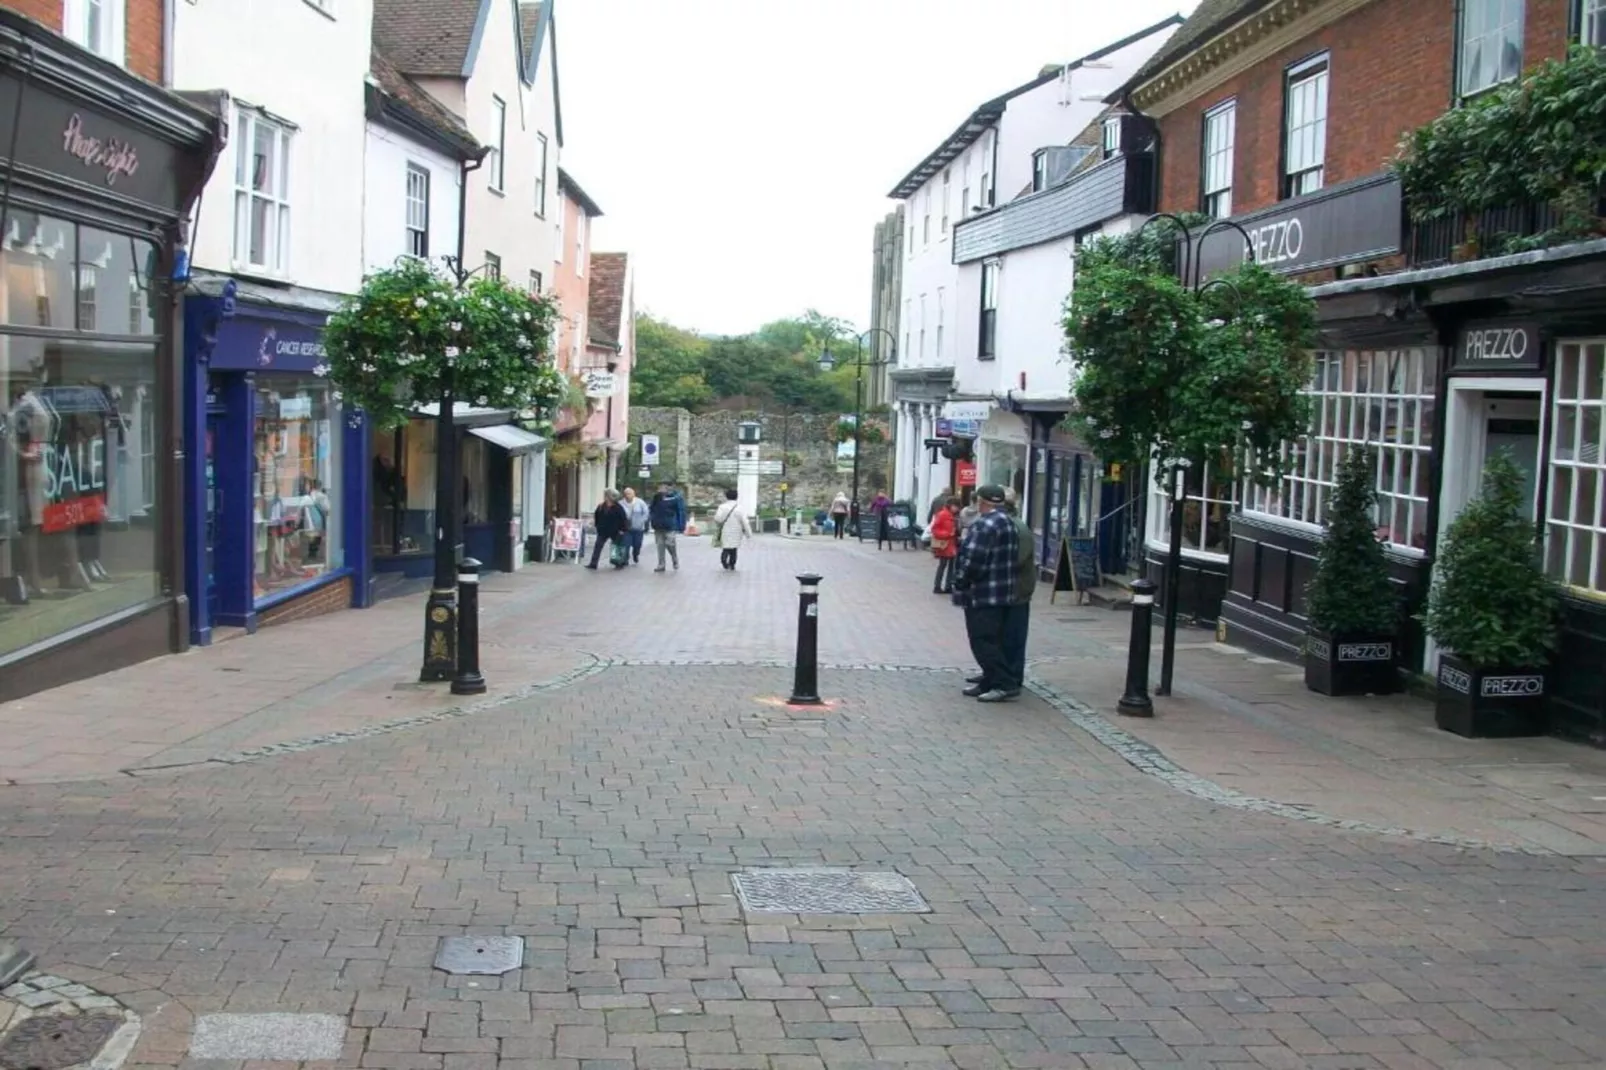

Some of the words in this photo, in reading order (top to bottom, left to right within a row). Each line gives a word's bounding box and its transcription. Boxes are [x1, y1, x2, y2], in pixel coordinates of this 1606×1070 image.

[1465, 328, 1527, 359] PREZZO
[43, 439, 104, 499] SALE
[1341, 645, 1389, 659] PREZZO
[1484, 679, 1541, 694] PREZZO
